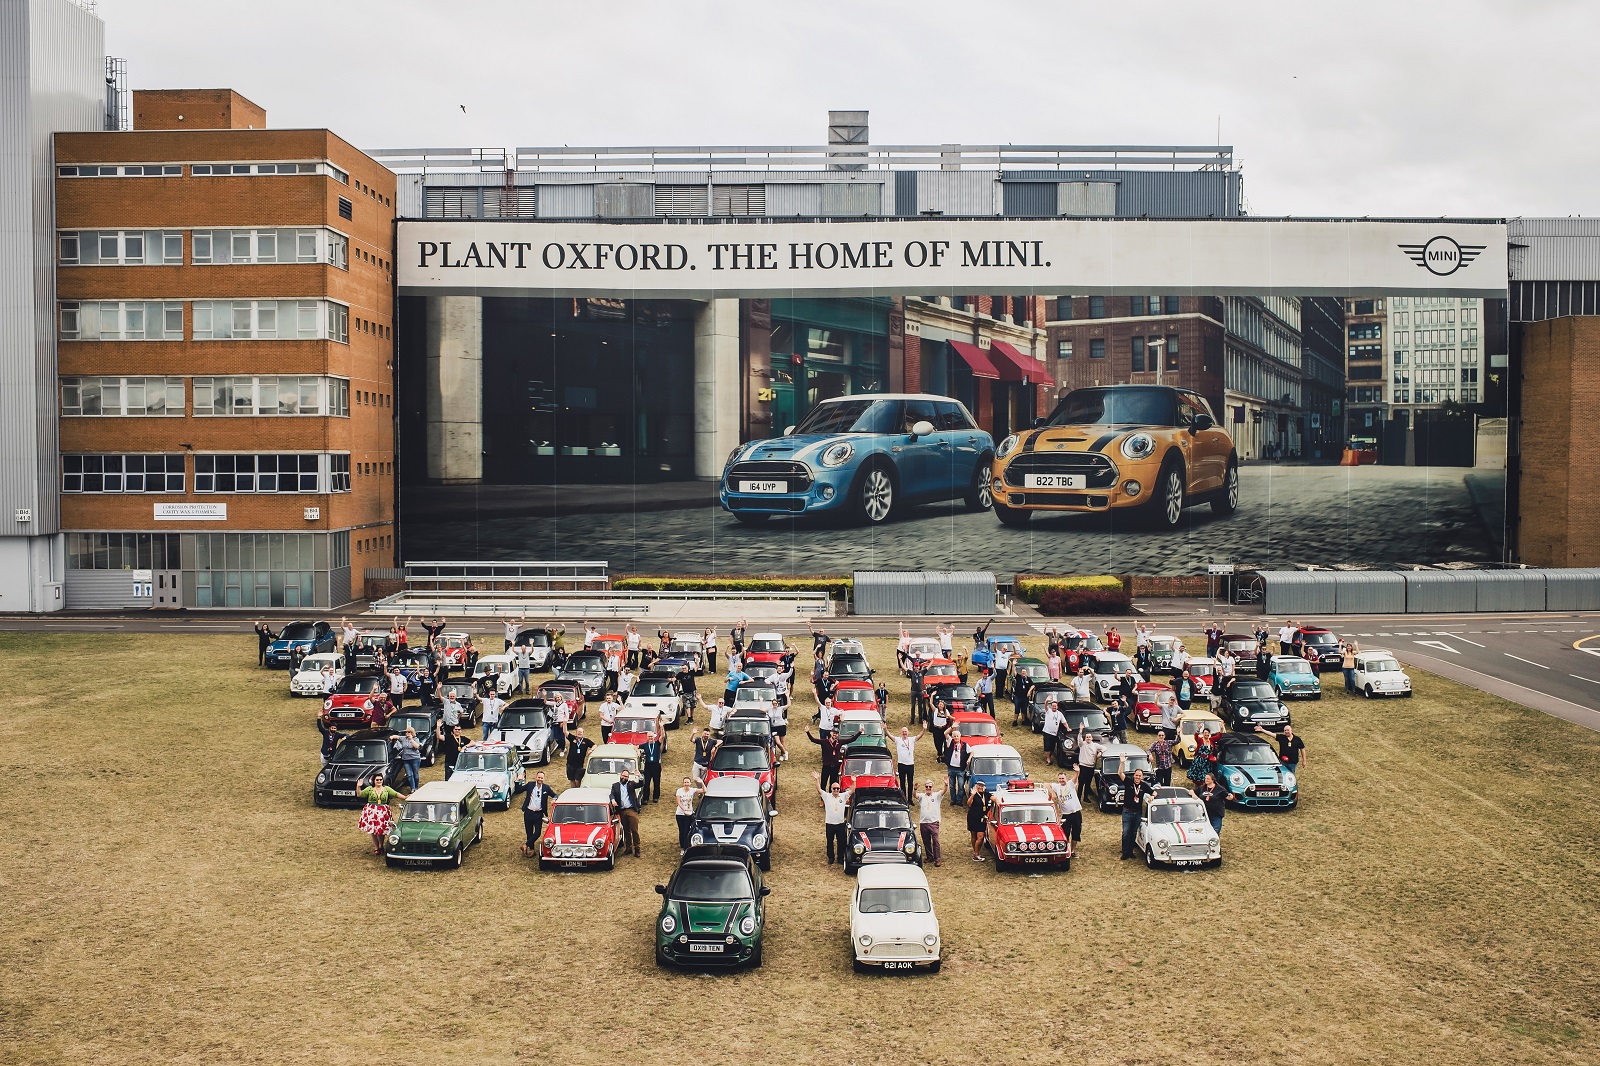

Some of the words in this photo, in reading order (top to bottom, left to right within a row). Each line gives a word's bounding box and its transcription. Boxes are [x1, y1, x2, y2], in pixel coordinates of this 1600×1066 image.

[417, 241, 531, 269] PLANT
[542, 243, 697, 270] OXFORD.
[708, 243, 778, 270] THE
[788, 242, 893, 269] HOME
[903, 240, 950, 268] OF
[960, 240, 1052, 268] MINI.
[1428, 250, 1457, 261] MINI
[1037, 476, 1054, 486] 822
[1056, 476, 1073, 486] TBG
[749, 482, 760, 491] 164
[762, 482, 776, 491] UYP
[884, 961, 896, 969] 621
[897, 961, 913, 969] AOK
